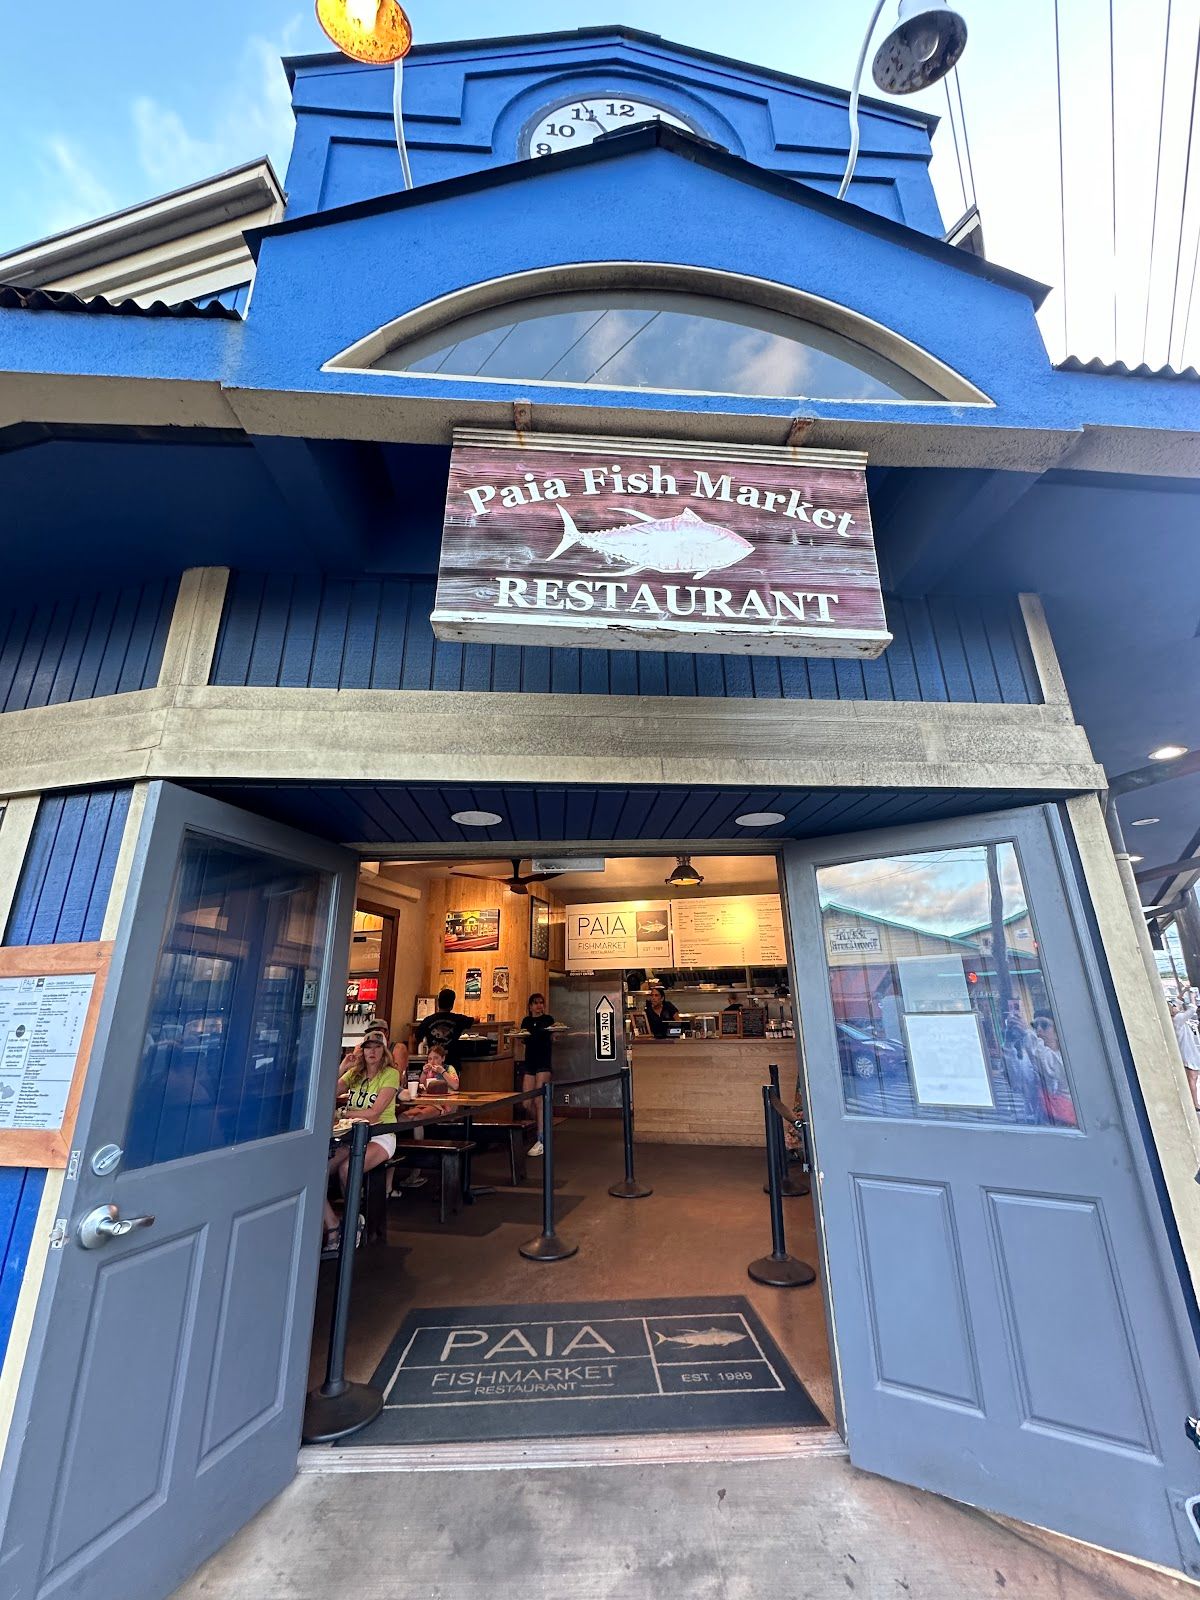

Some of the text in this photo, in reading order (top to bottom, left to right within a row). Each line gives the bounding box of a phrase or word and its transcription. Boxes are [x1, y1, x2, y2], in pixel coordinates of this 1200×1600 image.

[571, 108, 596, 121] 11
[606, 103, 635, 117] 12
[546, 123, 576, 138] 10
[464, 464, 857, 538] Paia Fish Market
[493, 576, 839, 623] RESTAURANT
[578, 915, 627, 936] PAIA
[578, 941, 627, 951] FISHMARKET
[601, 1012, 610, 1052] ONE WAY
[440, 1325, 616, 1362] PAIA
[431, 1365, 618, 1387] FISHMARKET
[718, 1371, 753, 1381] 1989
[474, 1382, 577, 1395] RESTAURANT
